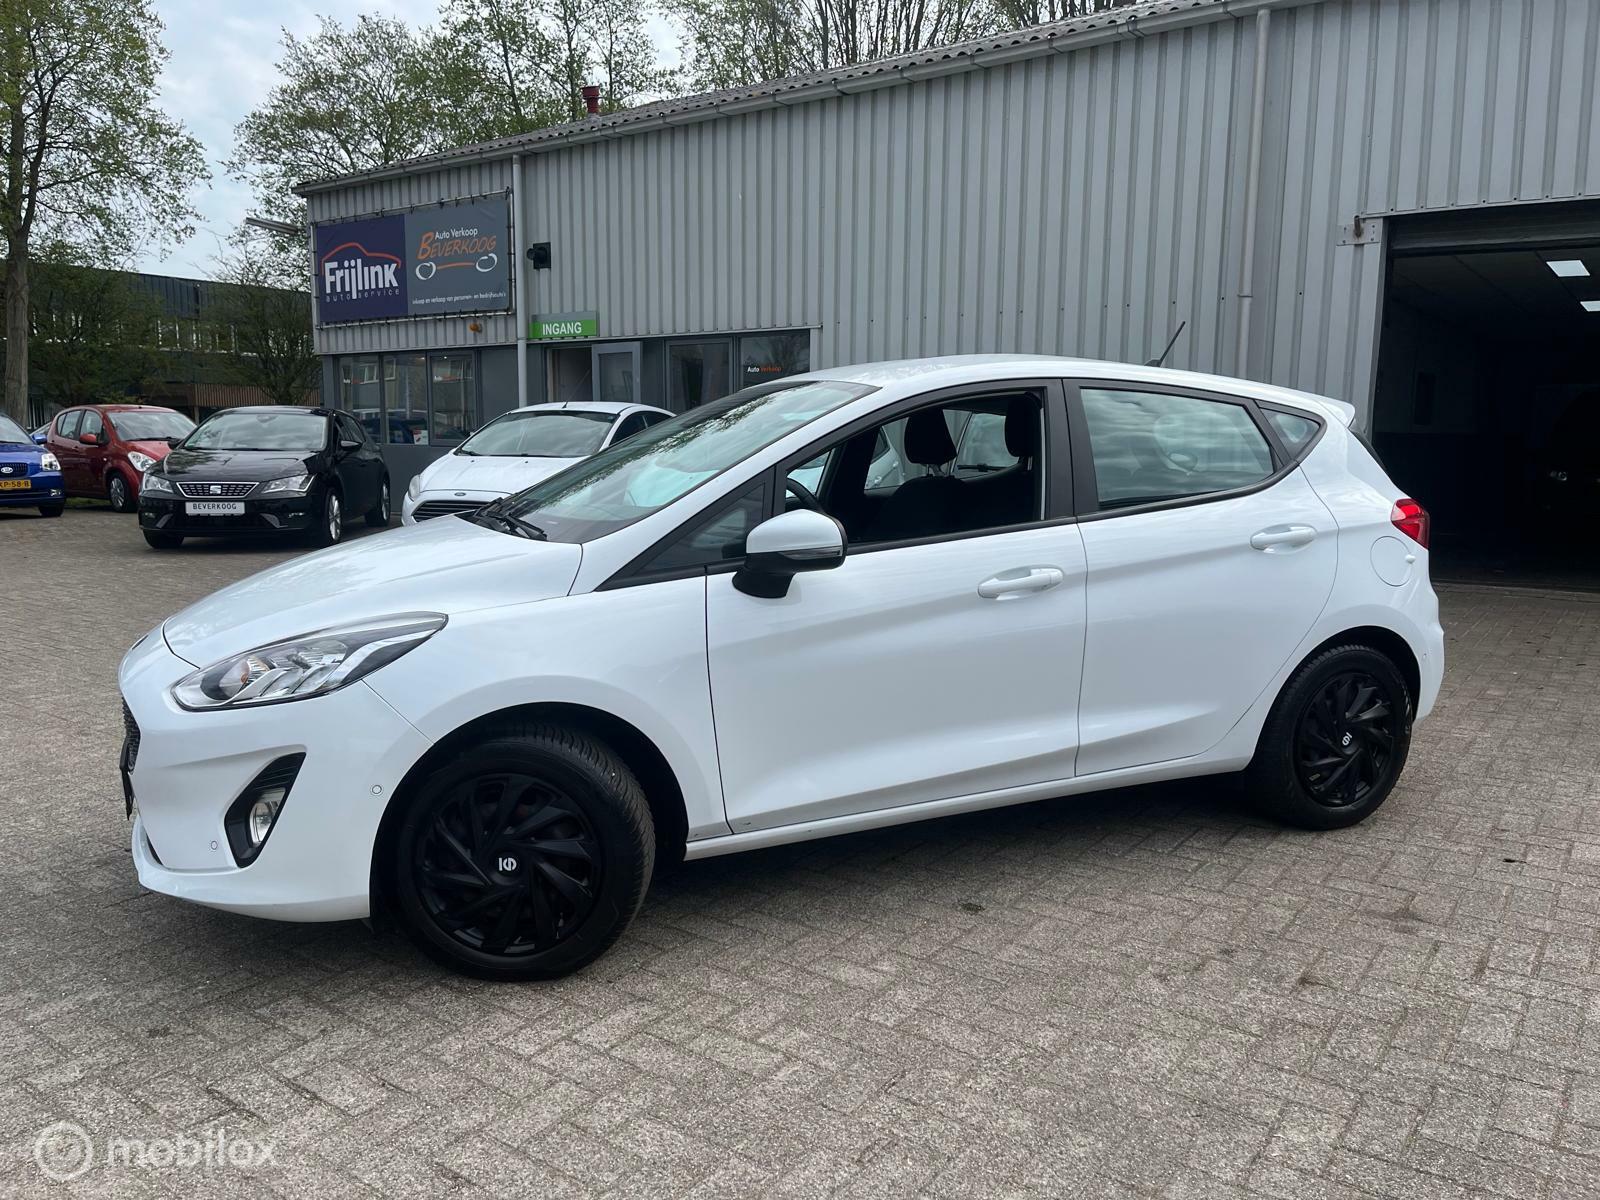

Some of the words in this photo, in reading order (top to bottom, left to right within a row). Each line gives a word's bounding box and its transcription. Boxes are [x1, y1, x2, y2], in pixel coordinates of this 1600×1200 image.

[434, 231, 450, 240] Auto
[450, 227, 478, 238] Verkoop
[416, 231, 497, 260] BEVERKOOG
[324, 258, 399, 300] Frijlink
[542, 321, 582, 336] INGANG
